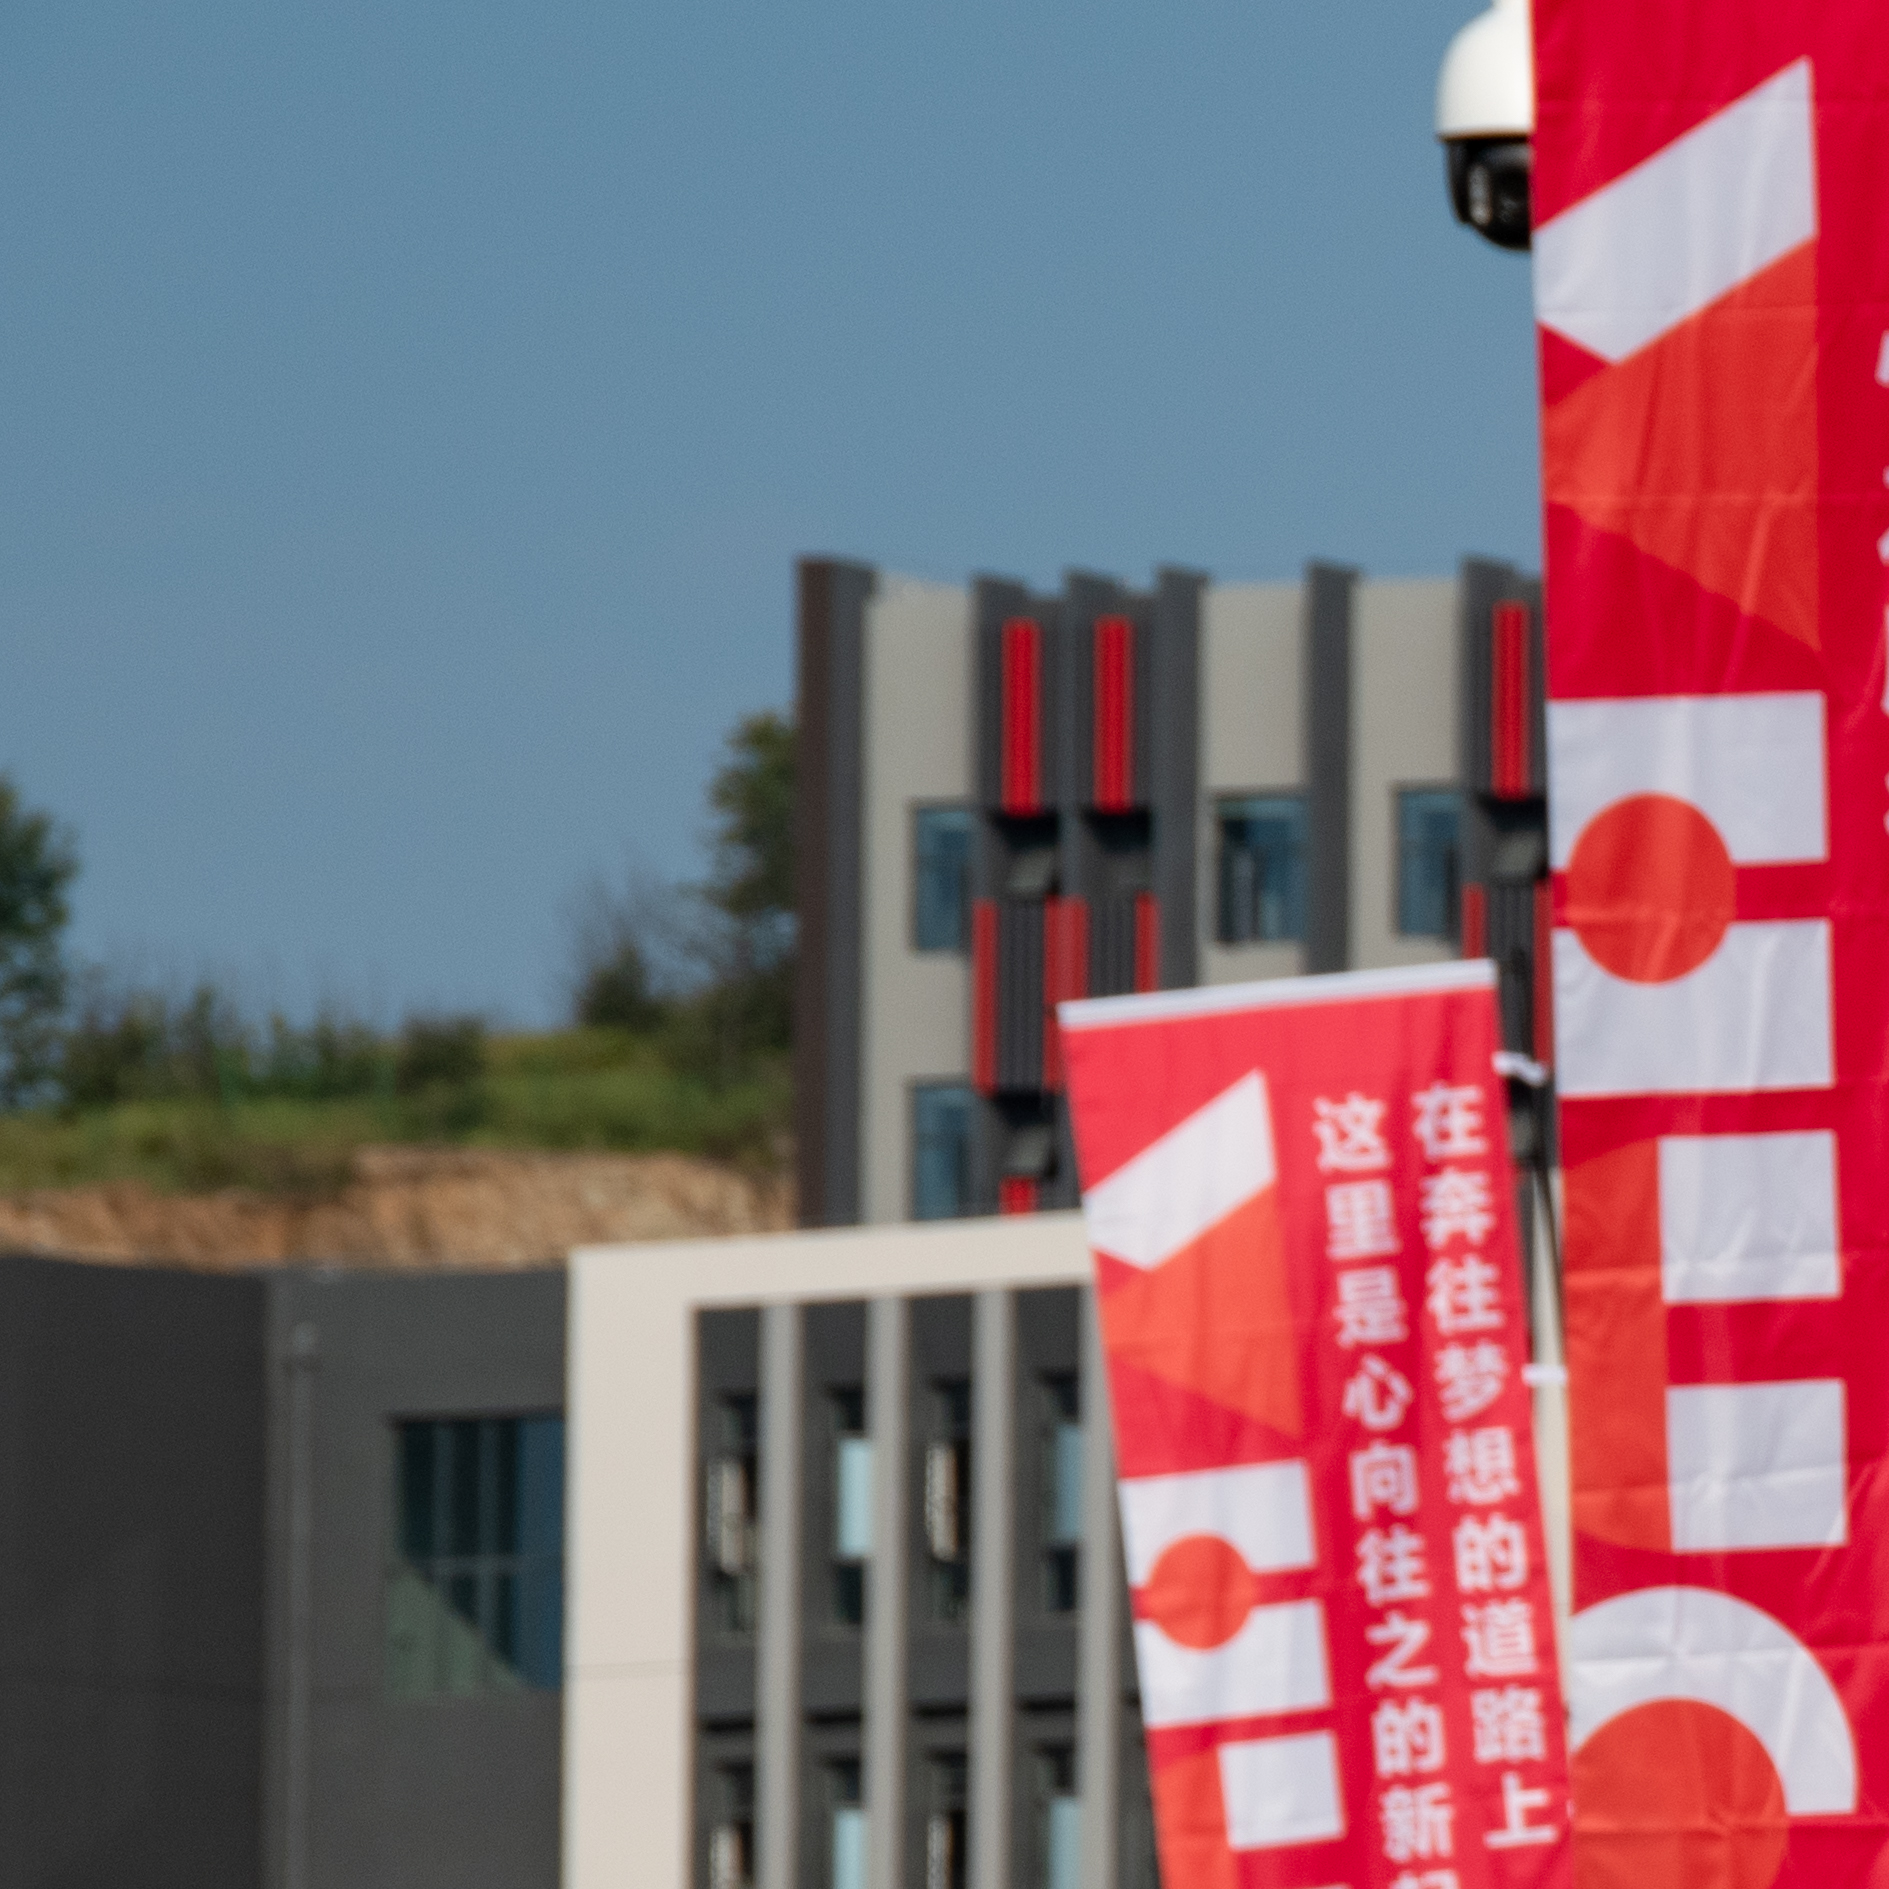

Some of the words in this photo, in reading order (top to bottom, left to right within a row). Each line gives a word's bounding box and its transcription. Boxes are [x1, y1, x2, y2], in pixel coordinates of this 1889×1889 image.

[1411, 1083, 1558, 1851] 在奔往梦想的道路上
